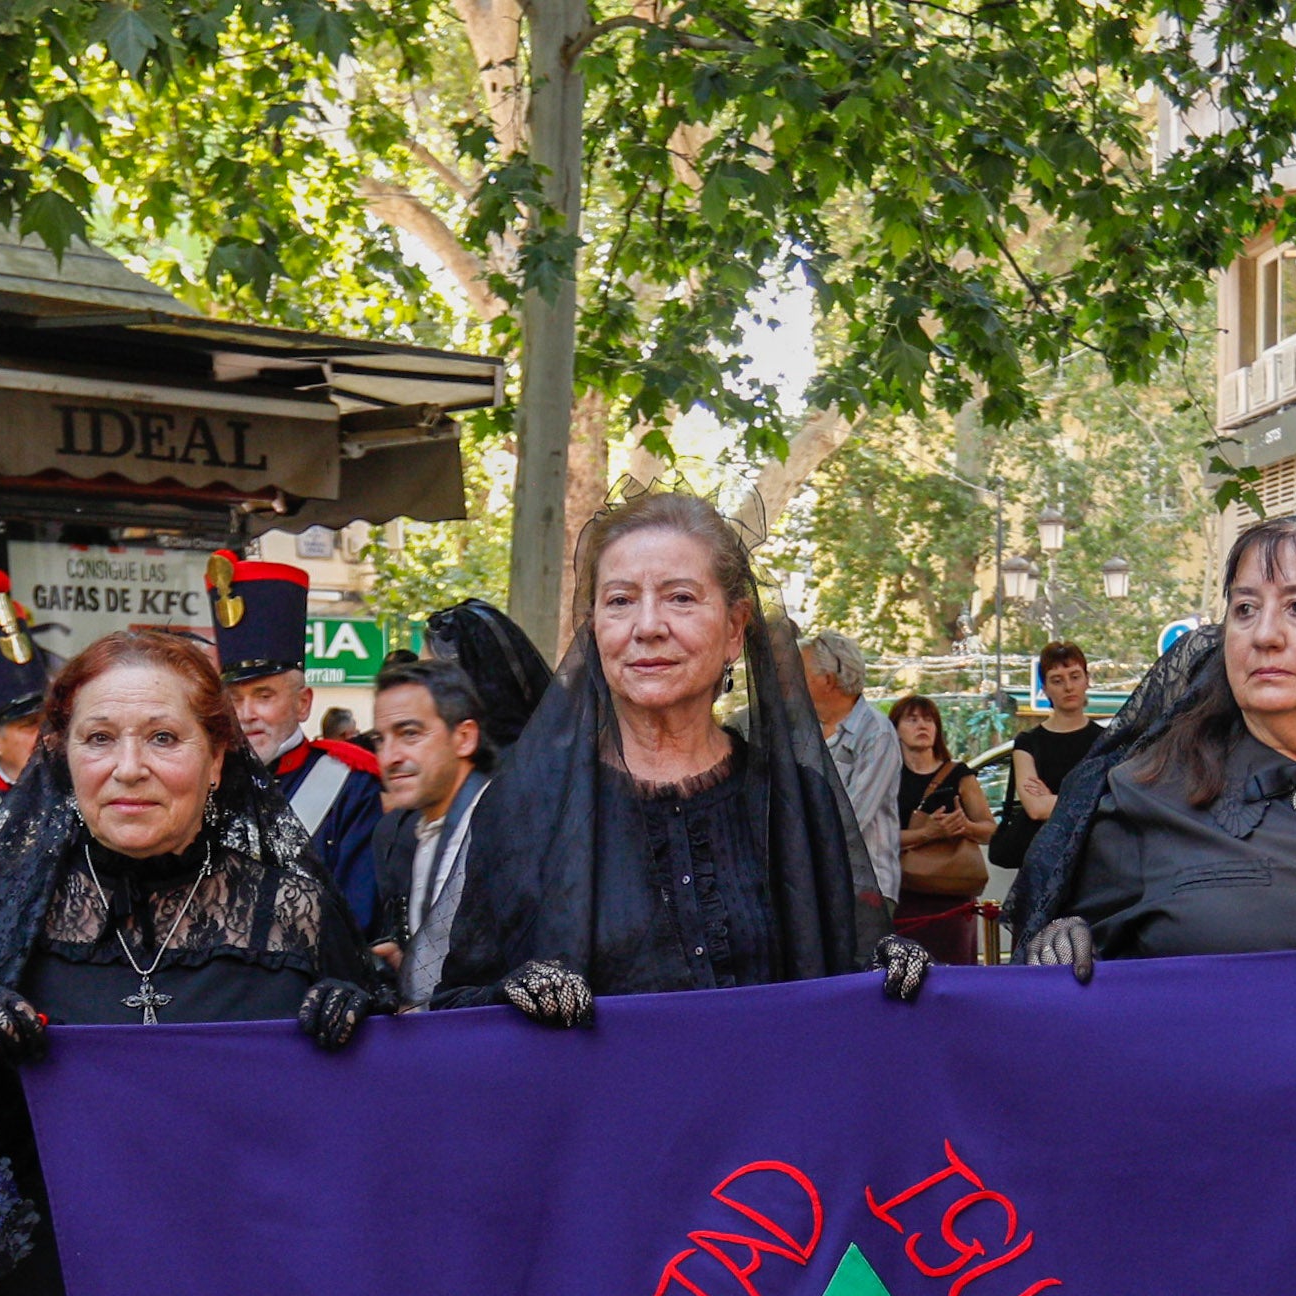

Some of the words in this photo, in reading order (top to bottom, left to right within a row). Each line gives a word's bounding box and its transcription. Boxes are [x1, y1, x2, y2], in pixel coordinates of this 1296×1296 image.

[52, 404, 268, 471] IDEAL
[66, 558, 136, 581] CONSIGUE
[140, 563, 168, 583] LAS
[33, 585, 100, 612] GAFAS
[106, 587, 131, 613] DE
[138, 590, 200, 617] KFC
[305, 621, 369, 660] IA
